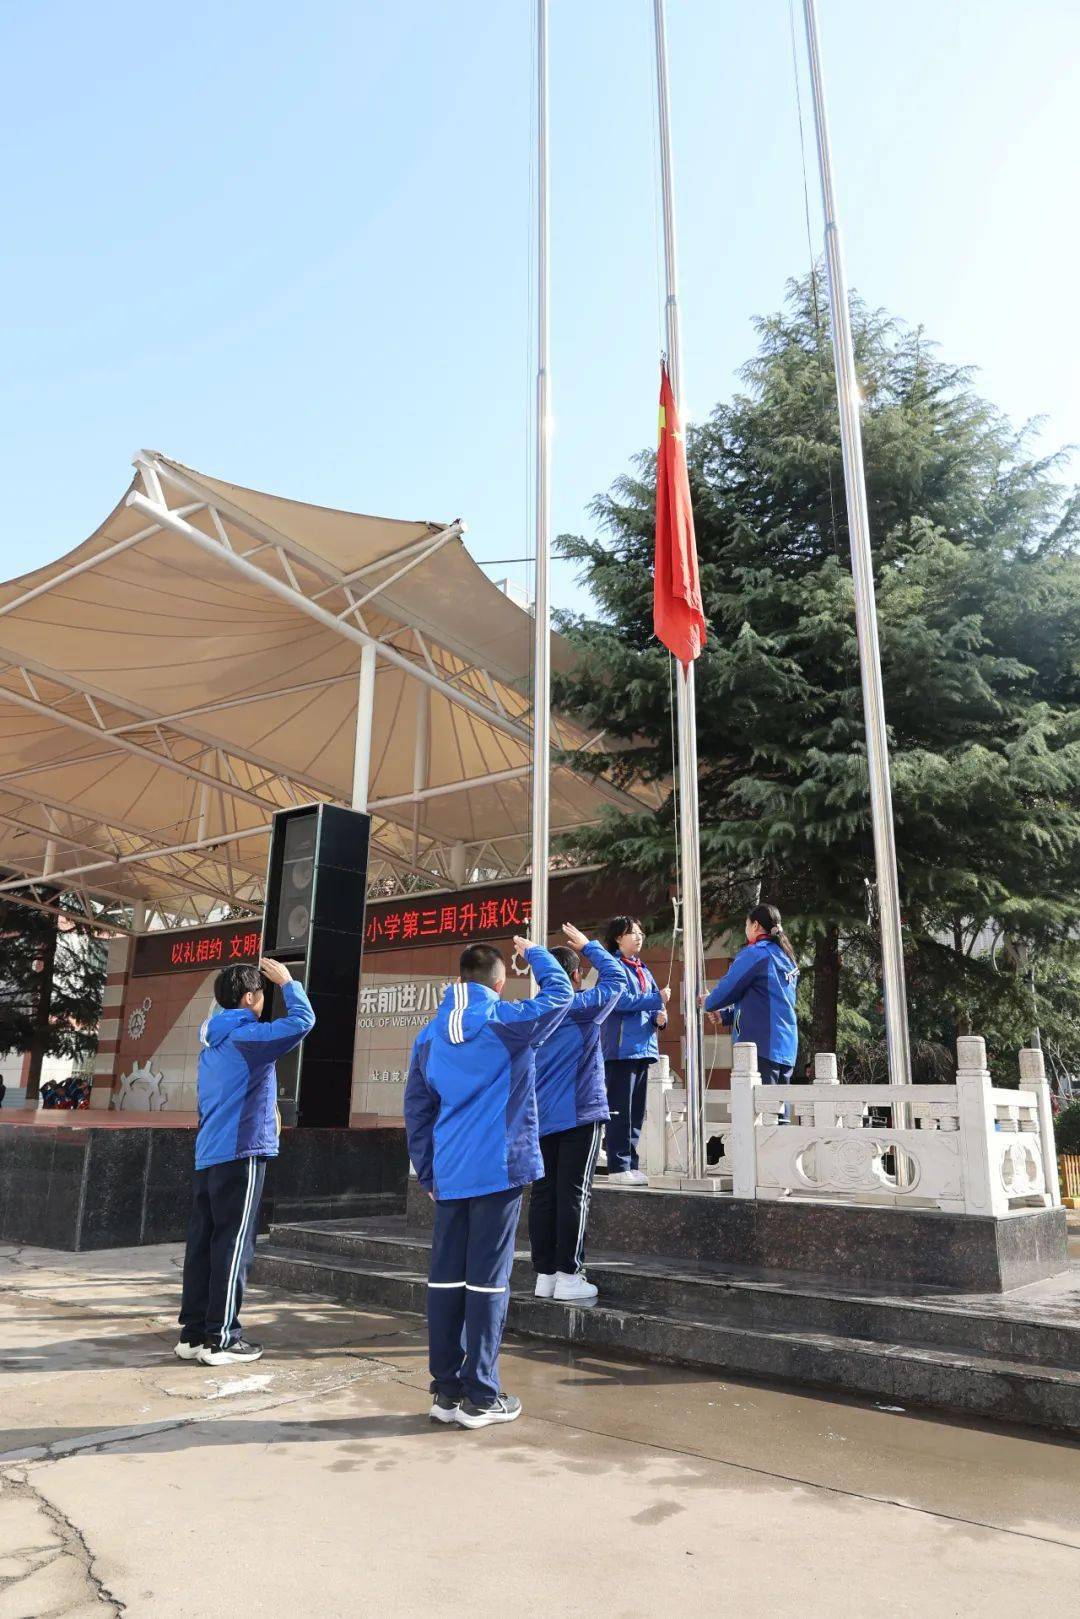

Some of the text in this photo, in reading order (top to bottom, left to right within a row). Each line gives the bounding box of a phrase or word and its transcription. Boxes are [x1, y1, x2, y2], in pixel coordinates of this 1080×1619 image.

[171, 938, 222, 965] 以礼相约
[228, 933, 262, 959] 文明
[379, 1017, 390, 1028] OF
[392, 1015, 429, 1027] WEIYANG
